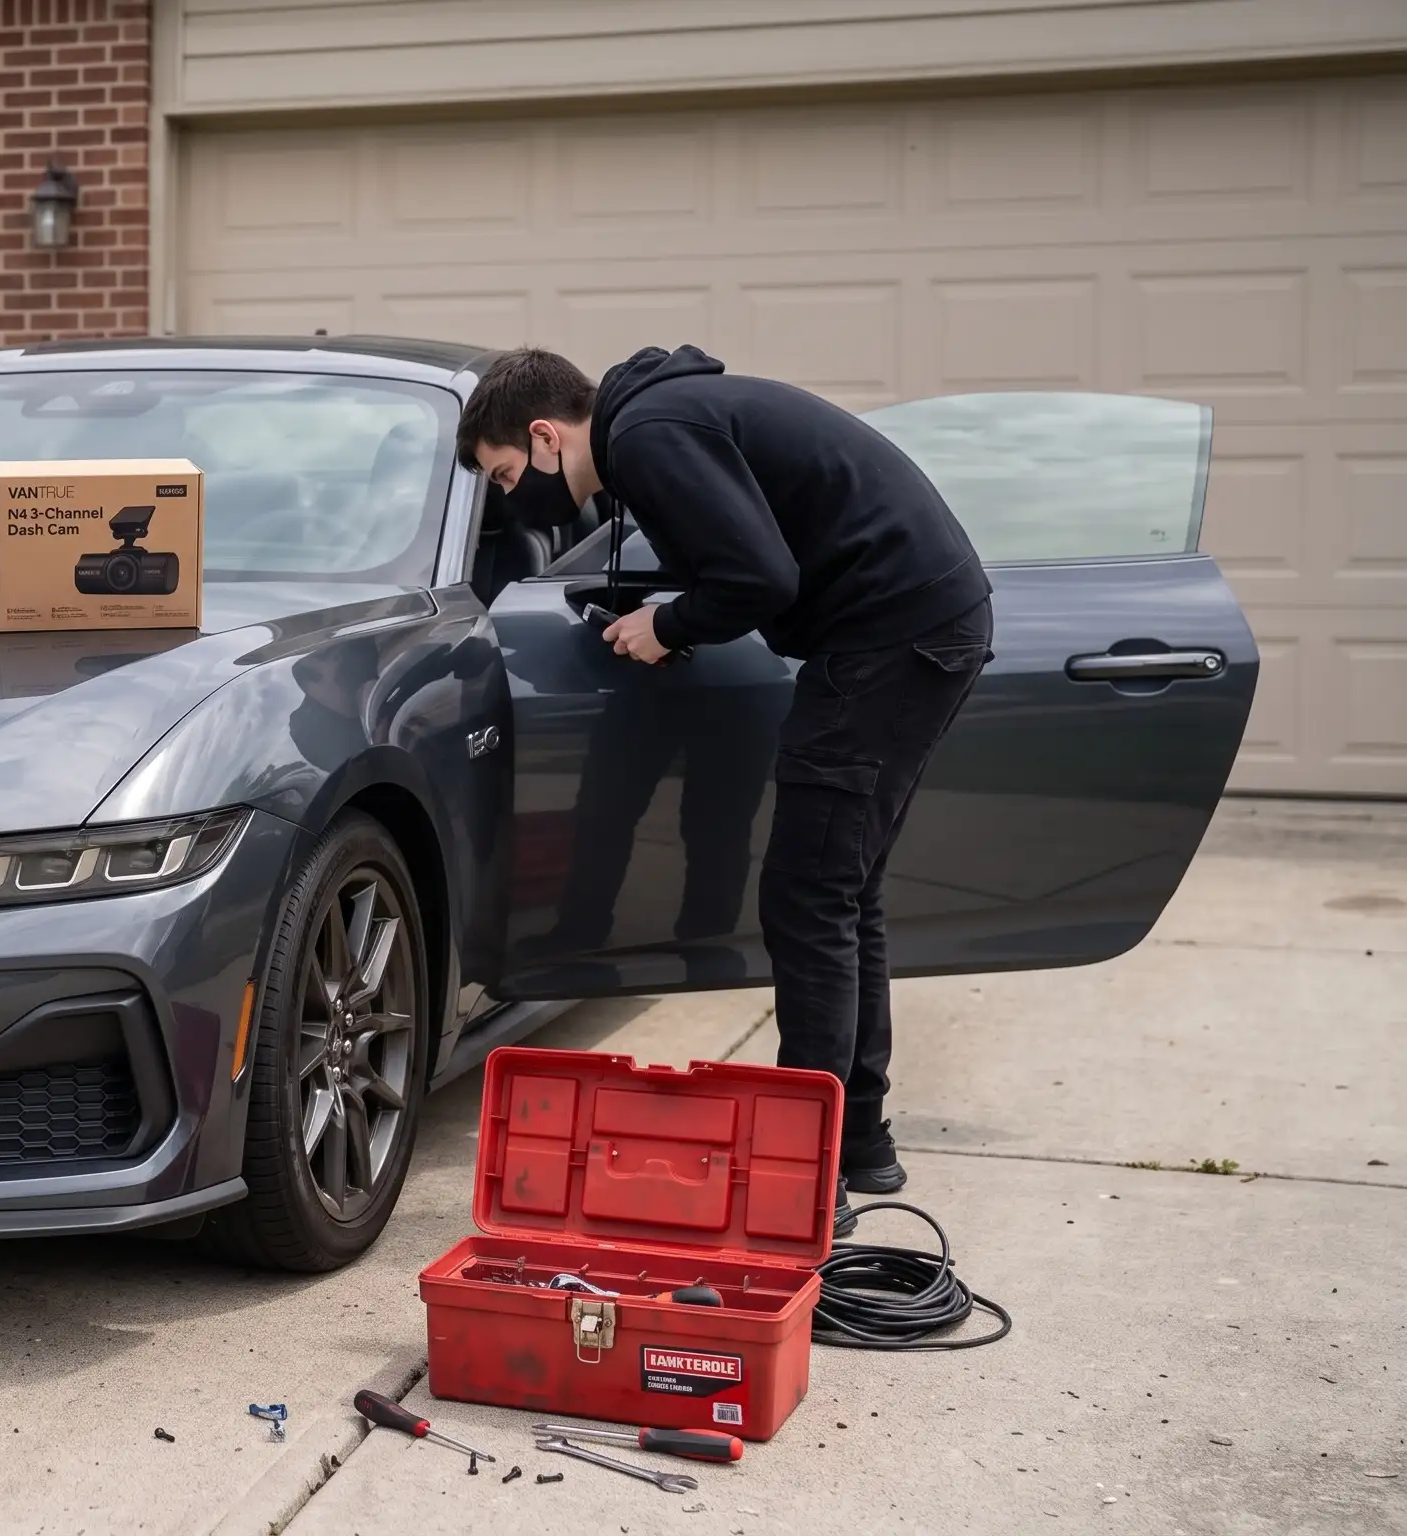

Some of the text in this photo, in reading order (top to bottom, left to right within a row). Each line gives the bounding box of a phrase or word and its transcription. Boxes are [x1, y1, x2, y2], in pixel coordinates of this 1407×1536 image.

[8, 486, 74, 499] VANTRUE
[8, 507, 103, 520] N4 3-Channel
[8, 523, 80, 536] Dash Cam
